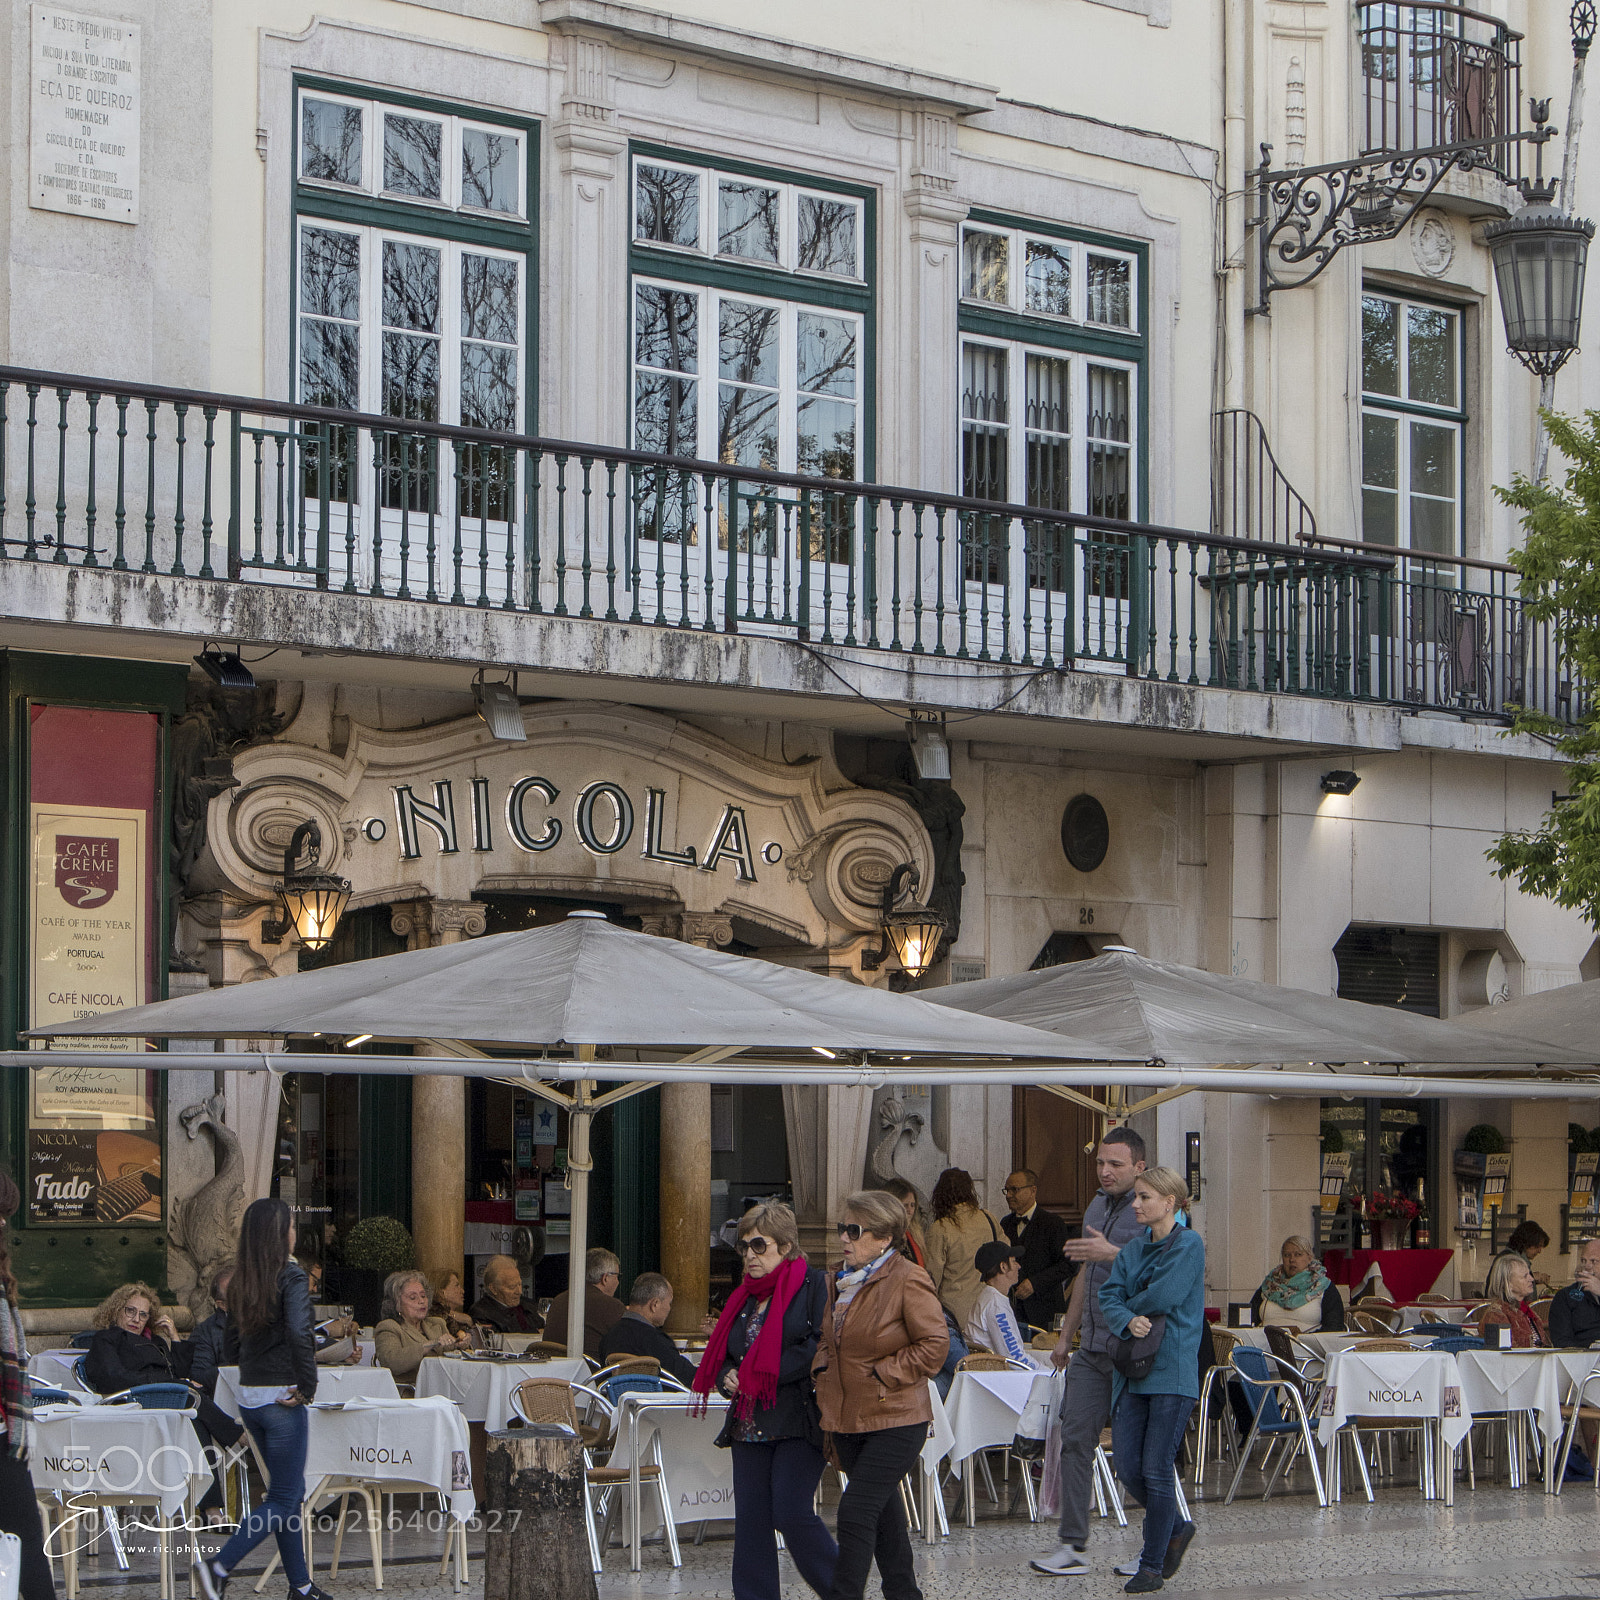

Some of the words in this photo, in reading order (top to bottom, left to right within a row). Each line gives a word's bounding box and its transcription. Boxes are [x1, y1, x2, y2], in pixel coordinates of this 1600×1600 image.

[54, 16, 74, 32] NESTE
[103, 25, 122, 41] VIVEU
[84, 38, 90, 49] E
[42, 45, 62, 60] INICIOU
[64, 50, 68, 60] A
[85, 53, 99, 66] VIDA
[58, 64, 62, 75] O
[64, 65, 88, 80] GRANDE
[90, 70, 118, 86] ESCRITOR
[41, 80, 62, 99] EÇA
[68, 85, 82, 101] DE
[86, 88, 132, 110] QUEIROZ
[65, 107, 108, 126] HOMENAGEM
[82, 126, 92, 136] DO
[90, 140, 98, 152] DE
[100, 143, 126, 157] QUEIROZ
[78, 154, 83, 163] E
[86, 154, 94, 166] DA
[55, 162, 80, 178] SOCIEDADE
[82, 166, 88, 178] DE
[90, 168, 118, 184] ESCRITORES
[38, 174, 42, 184] E
[44, 175, 78, 191] COMPOSITORES
[79, 180, 100, 194] TEATRAIS
[102, 185, 132, 200] PORTUGUESES
[66, 194, 82, 205] 1866
[90, 198, 106, 210] 1966
[389, 775, 758, 883] NICOLA
[66, 842, 108, 858] CAFÉ
[60, 856, 114, 873] CRÈME
[40, 916, 65, 927] CAFÉ
[68, 918, 80, 928] OF
[82, 919, 102, 928] THE
[105, 920, 132, 930] YEAR
[1080, 907, 1094, 925] 26
[72, 933, 101, 942] AWARD
[67, 949, 105, 959] PORTUGAL
[76, 963, 97, 971] 2000
[48, 990, 78, 1004] CAFÉ
[82, 993, 124, 1006] NICOLA
[70, 1086, 102, 1094] ACKERMAN
[38, 1134, 78, 1146] NICOLA
[55, 1153, 62, 1164] of
[1488, 1156, 1508, 1166] Lisboa
[1578, 1156, 1597, 1164] Lisboa
[62, 1162, 85, 1173] Noites
[86, 1164, 94, 1172] de
[34, 1173, 95, 1200] Fado
[1368, 1390, 1423, 1403] NICOLA
[350, 1446, 413, 1465] NICOLA
[44, 1456, 110, 1473] NICOLA
